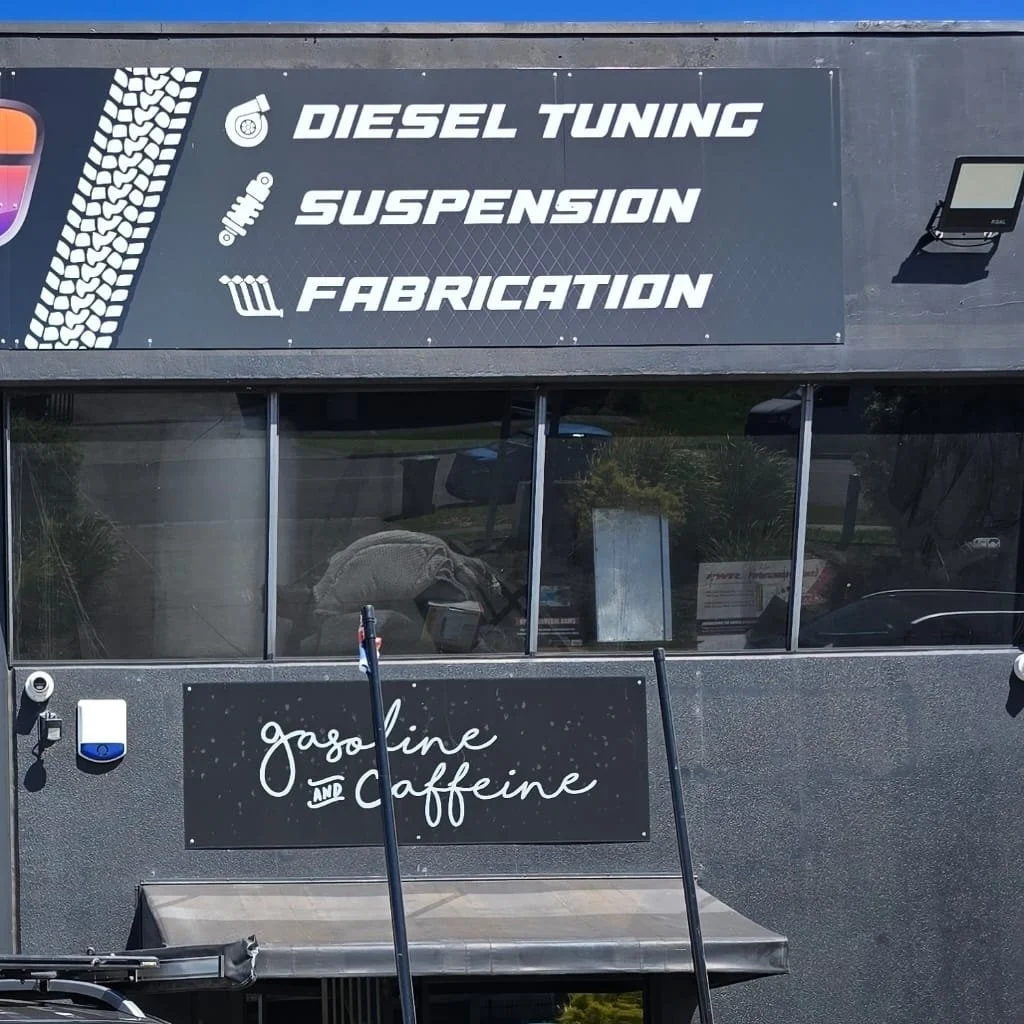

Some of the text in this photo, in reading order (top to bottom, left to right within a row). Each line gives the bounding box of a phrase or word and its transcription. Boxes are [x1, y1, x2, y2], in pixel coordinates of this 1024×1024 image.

[292, 102, 764, 140] DIESEL TUNING
[294, 187, 702, 226] SUSPENSION
[295, 272, 713, 313] FABRICATION
[259, 698, 498, 798] gasoline
[311, 784, 344, 805] AND
